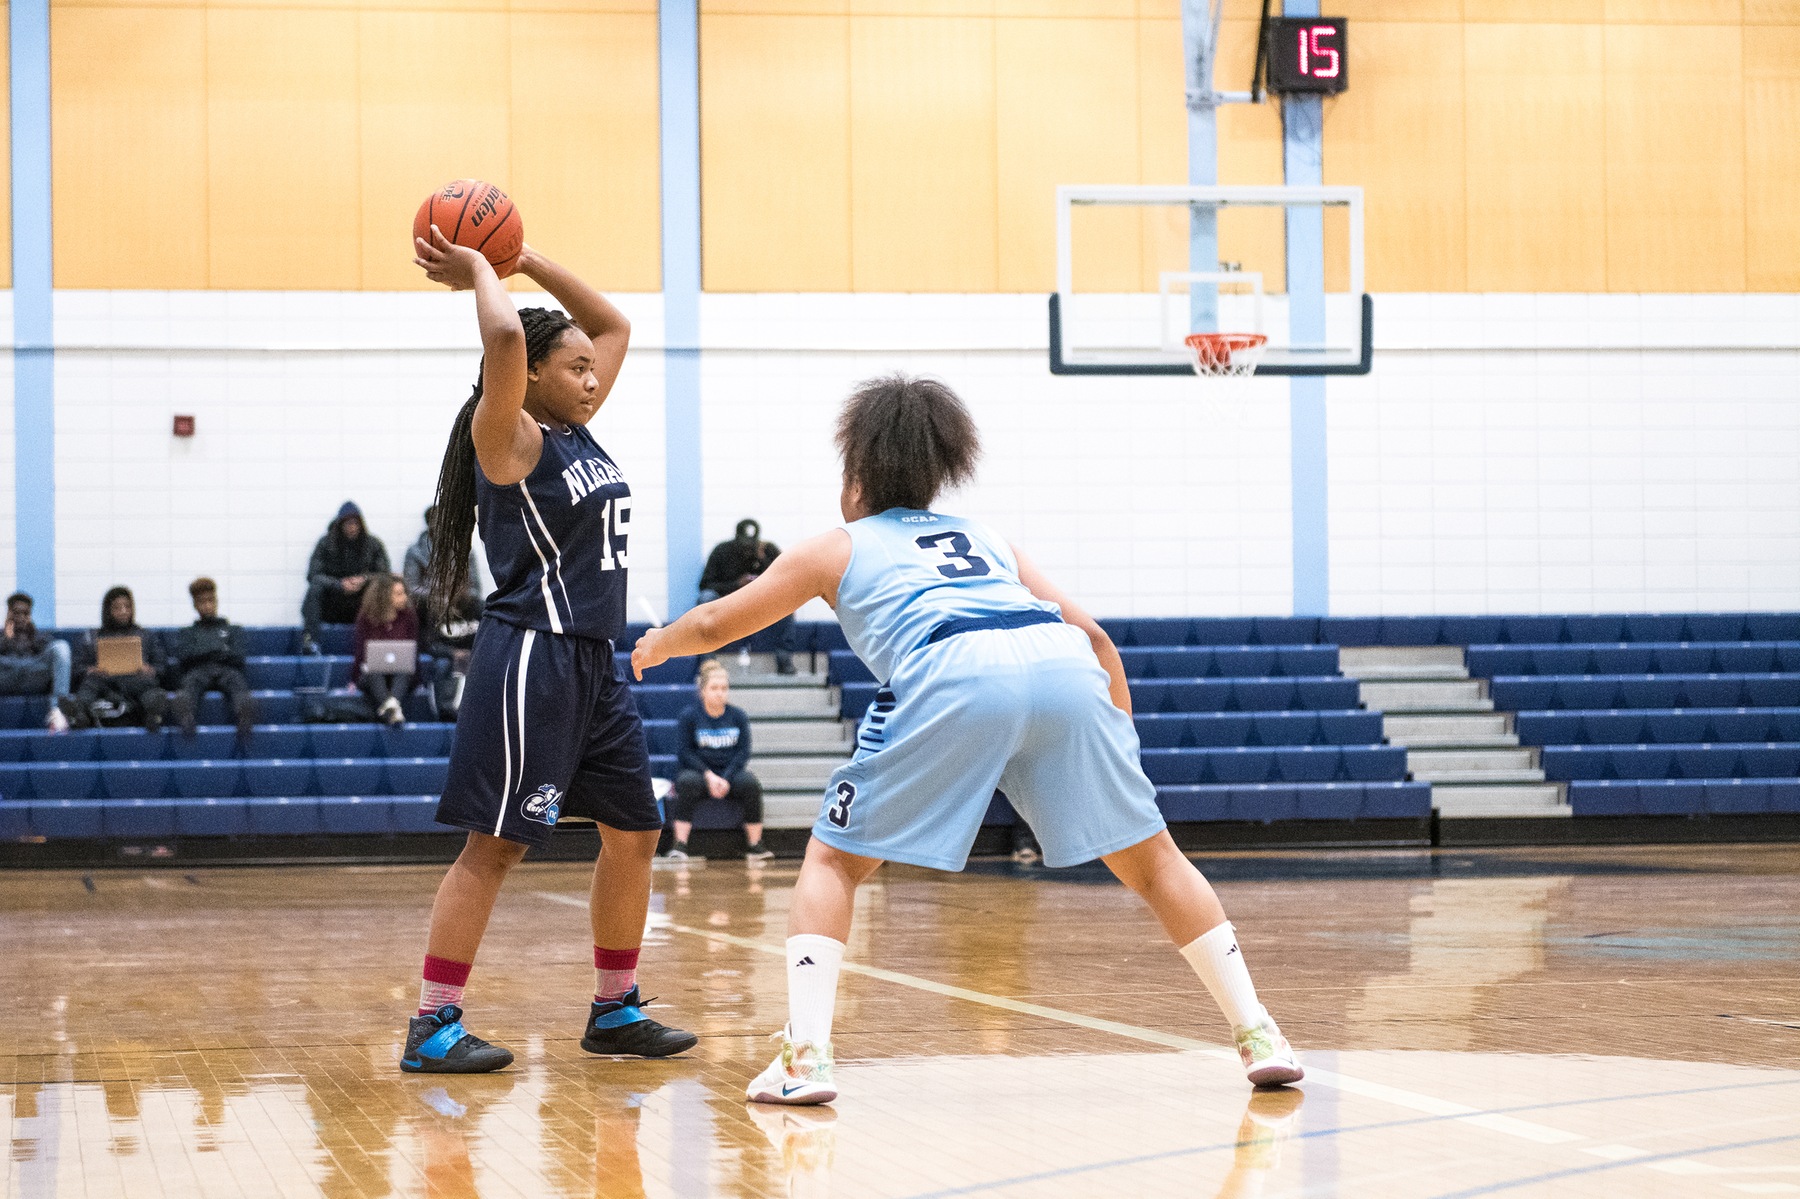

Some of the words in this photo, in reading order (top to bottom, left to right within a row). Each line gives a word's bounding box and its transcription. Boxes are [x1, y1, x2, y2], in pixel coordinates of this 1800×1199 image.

[1298, 26, 1340, 78] 15
[601, 496, 632, 571] 15
[914, 530, 991, 579] 3
[828, 780, 857, 829] 3
